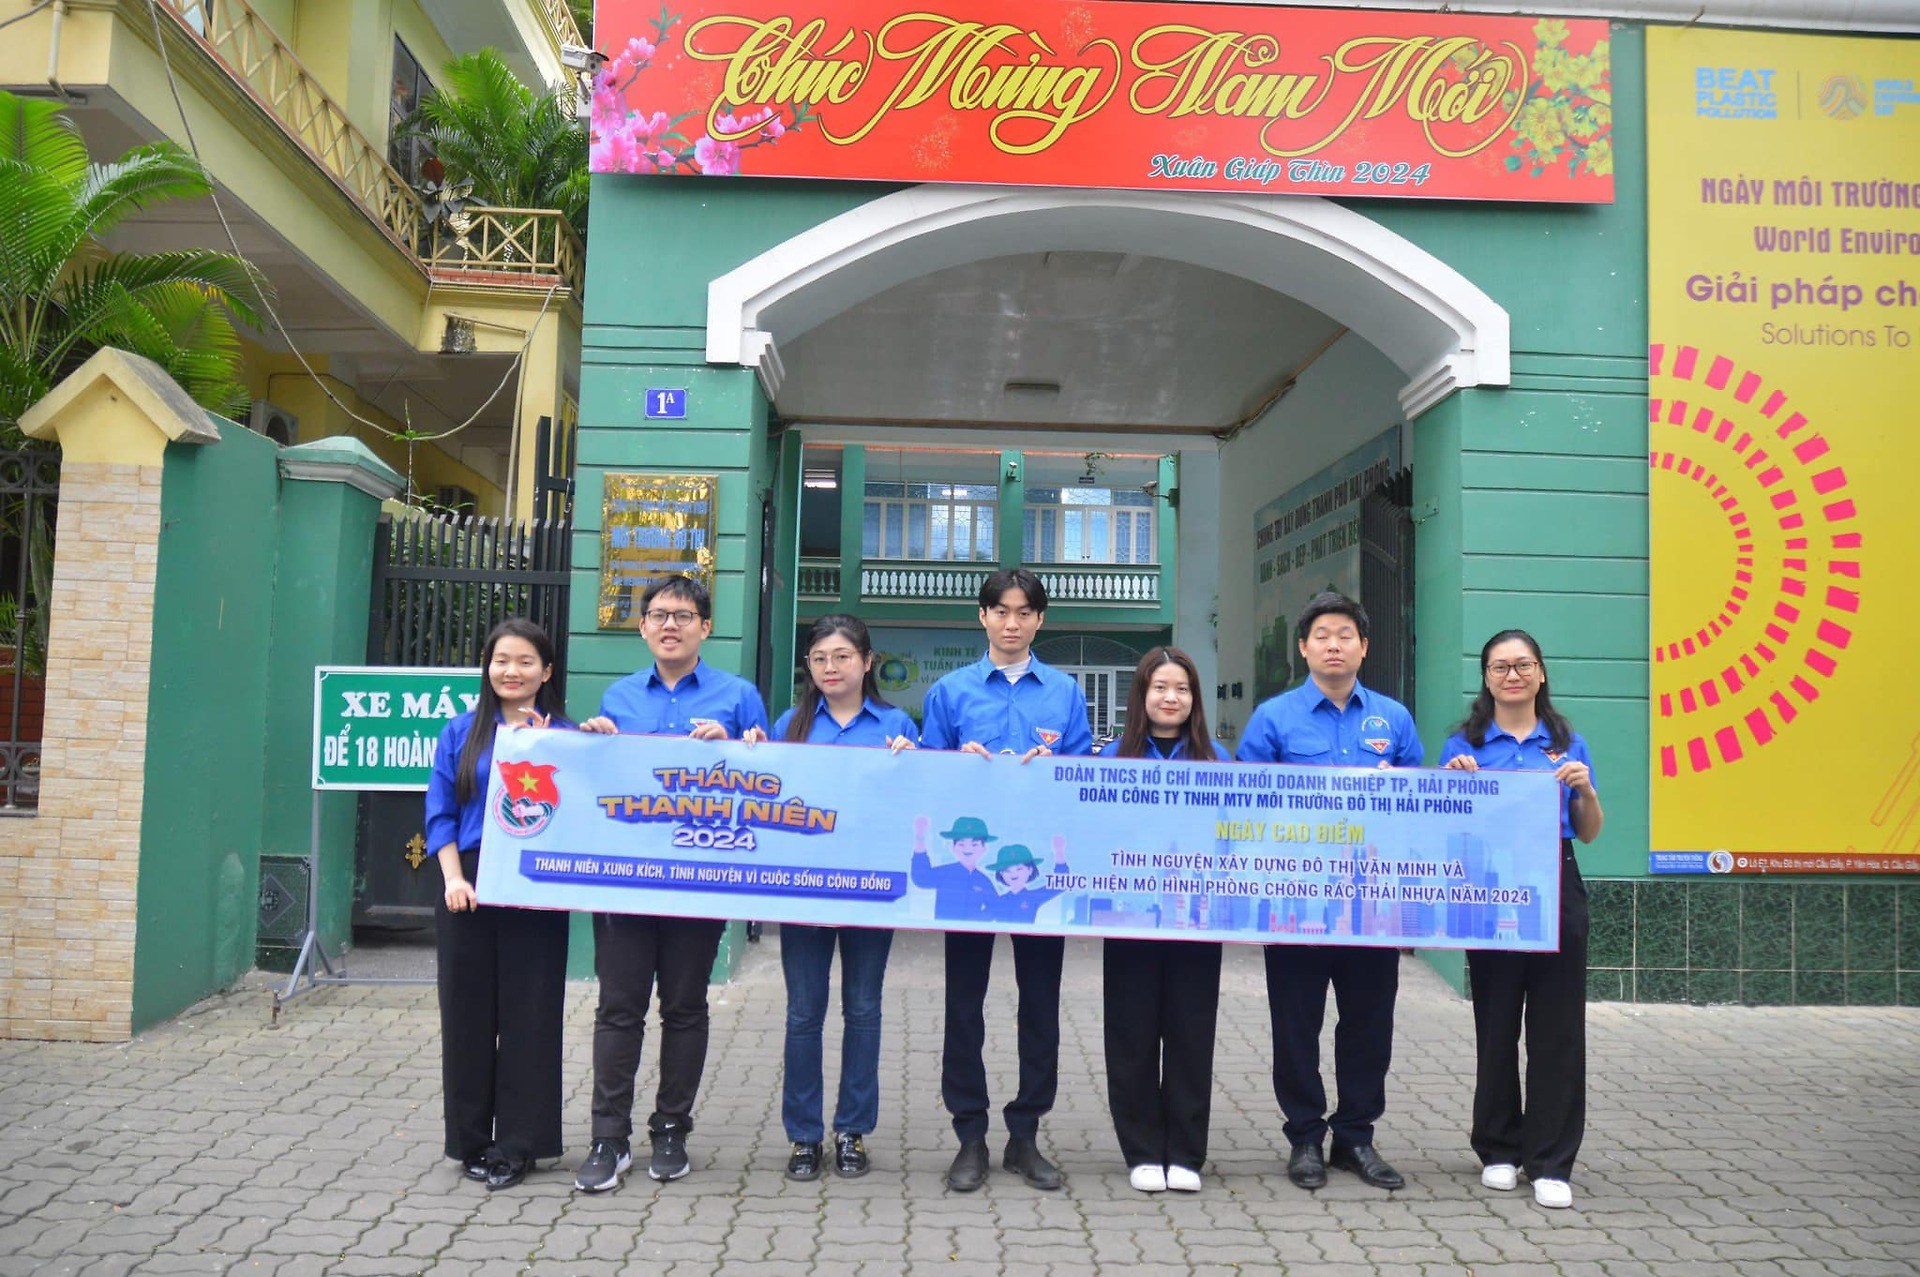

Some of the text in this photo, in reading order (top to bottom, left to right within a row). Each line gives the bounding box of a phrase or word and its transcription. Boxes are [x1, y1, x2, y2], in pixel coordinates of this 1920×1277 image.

[683, 15, 874, 141] Chúc
[818, 12, 1122, 155] Mừng
[1260, 36, 1529, 157] Mới
[1696, 67, 1777, 91] BEAT
[1696, 91, 1777, 106] PLASTIC
[1149, 154, 1431, 186] Xuân Giáp Thìn 2024
[1701, 174, 1764, 204] NGÀY
[1774, 175, 1822, 206] MÔI
[1754, 226, 1830, 252] World
[1686, 272, 1920, 311] Giải pháp ch
[1762, 322, 1911, 347] Solutions To
[656, 392, 675, 414] 1A
[340, 691, 391, 718] XE
[324, 723, 351, 767] ĐỂ
[356, 736, 379, 767] 18
[654, 760, 782, 796] THÁNG
[1054, 763, 1095, 783] ĐOÀN
[1099, 767, 1137, 784] TNCS
[1141, 764, 1162, 785] HỒ
[1166, 767, 1190, 786] CHÍ
[1195, 771, 1233, 788] MINH
[1238, 768, 1272, 789] KHỐI
[1277, 774, 1327, 791] DOANH
[1331, 773, 1385, 795] NGHIỆP
[1418, 773, 1442, 794] HẢI
[1449, 776, 1500, 796] PHÒNG
[598, 795, 837, 833] THANH NIÊN
[1079, 784, 1473, 815] ĐOÀN CÔNG TY TNHH MTV MÔI TRƯỜNG ĐÔ THỊ HẢI PHÒNG
[672, 826, 756, 850] 2024
[1215, 817, 1365, 845] NGÀY CAO ĐIỂM
[535, 857, 892, 891] THANH NIÊN XUNG KÍCH, TÌNH NGUYỆN VÌ CUỘC SỐNG CỘNG ĐỒNG
[1111, 850, 1465, 878] TÌNH NGUYỆN XÂY DỰNG ĐÔ THỊ VĂN MINH VÀ
[1045, 873, 1529, 904] THỰC HIỆN MÔ HÌNH PHÒNG CHỐNG RÁC THẢI NHỰA NĂM 2024
